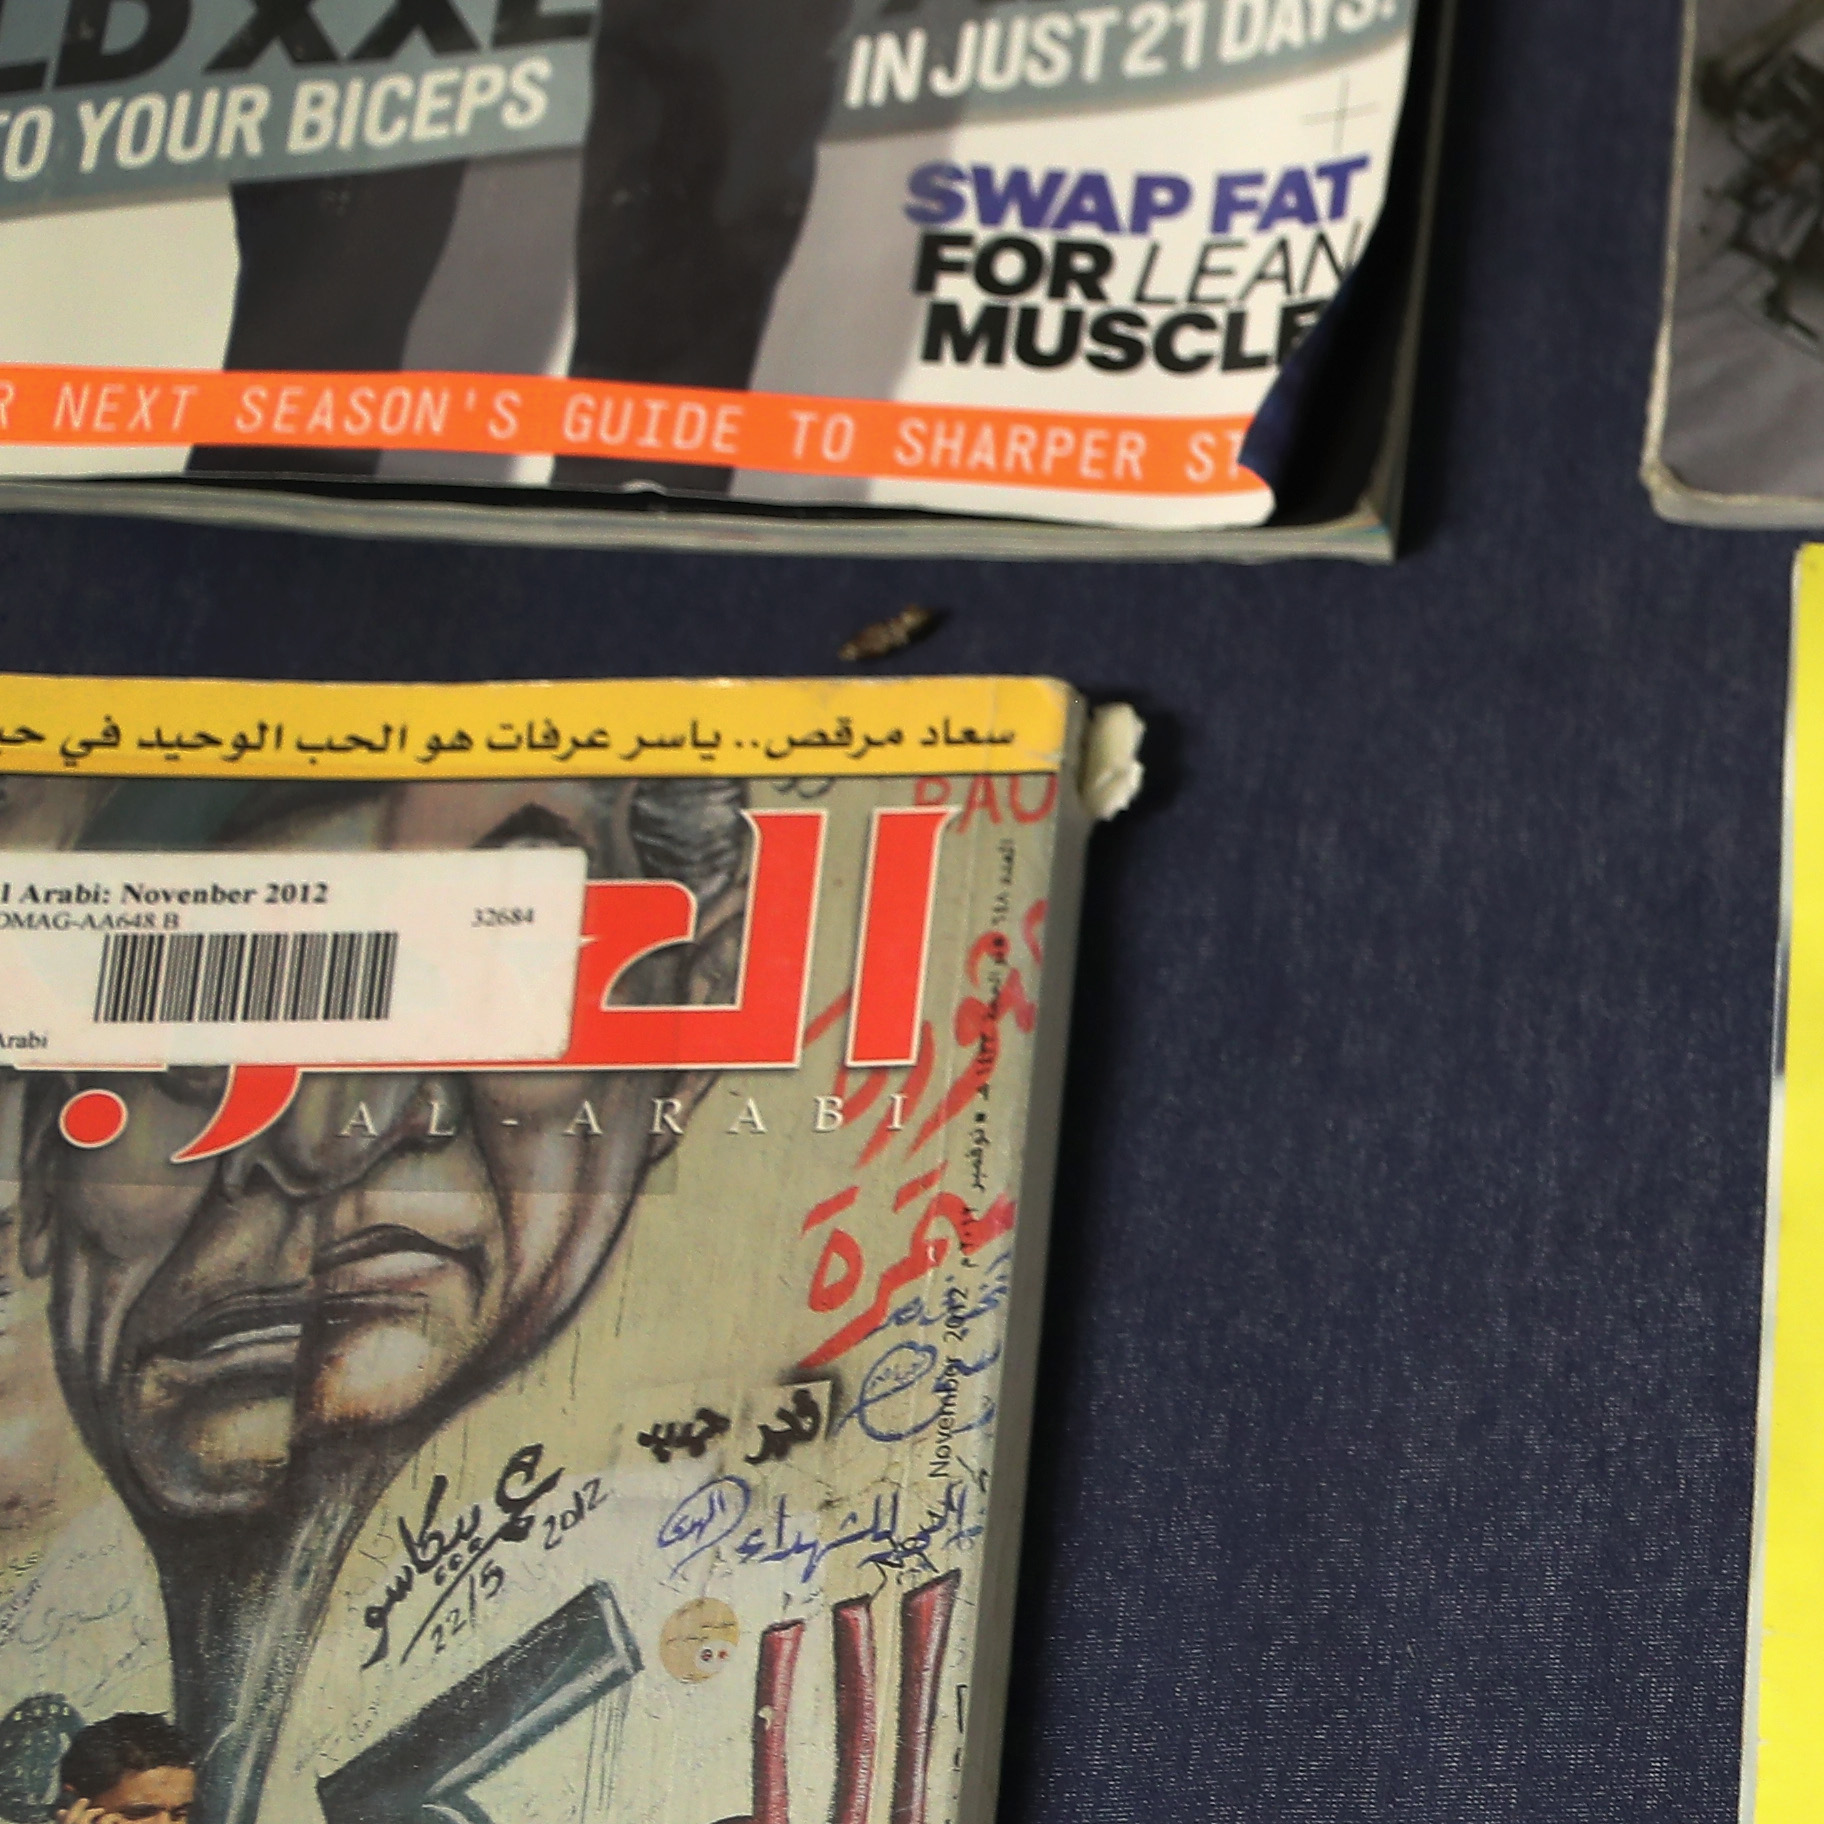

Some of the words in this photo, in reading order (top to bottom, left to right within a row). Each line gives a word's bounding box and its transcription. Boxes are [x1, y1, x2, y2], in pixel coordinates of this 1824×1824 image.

[843, 30, 926, 109] IN
[928, 10, 1118, 96] JUST
[1123, 0, 1207, 80] 21
[78, 82, 272, 174] YOUR
[285, 56, 553, 153] BICEPS
[903, 158, 1192, 236] SWAP
[1210, 151, 1369, 235] FAT
[913, 232, 1116, 300] FOR
[1133, 218, 1364, 307] LEAN
[52, 383, 197, 434] NEXT
[234, 384, 523, 441] SEASON'S
[561, 391, 744, 455] GUIDE
[787, 410, 856, 462] TO
[894, 417, 1145, 480] SHARPER
[59, 714, 122, 768] في
[137, 721, 285, 763] الوحيد
[296, 722, 407, 766] الحب
[415, 727, 474, 764] هو
[485, 717, 611, 761] عرفات
[619, 718, 722, 762] ياسر
[919, 715, 1016, 749] سعاد
[19, 882, 111, 906] Arabi:
[121, 882, 256, 906] Novenber
[263, 882, 328, 904] 2012
[470, 907, 536, 930] 32684
[929, 1356, 961, 1478] November
[541, 1477, 609, 1550] 2012
